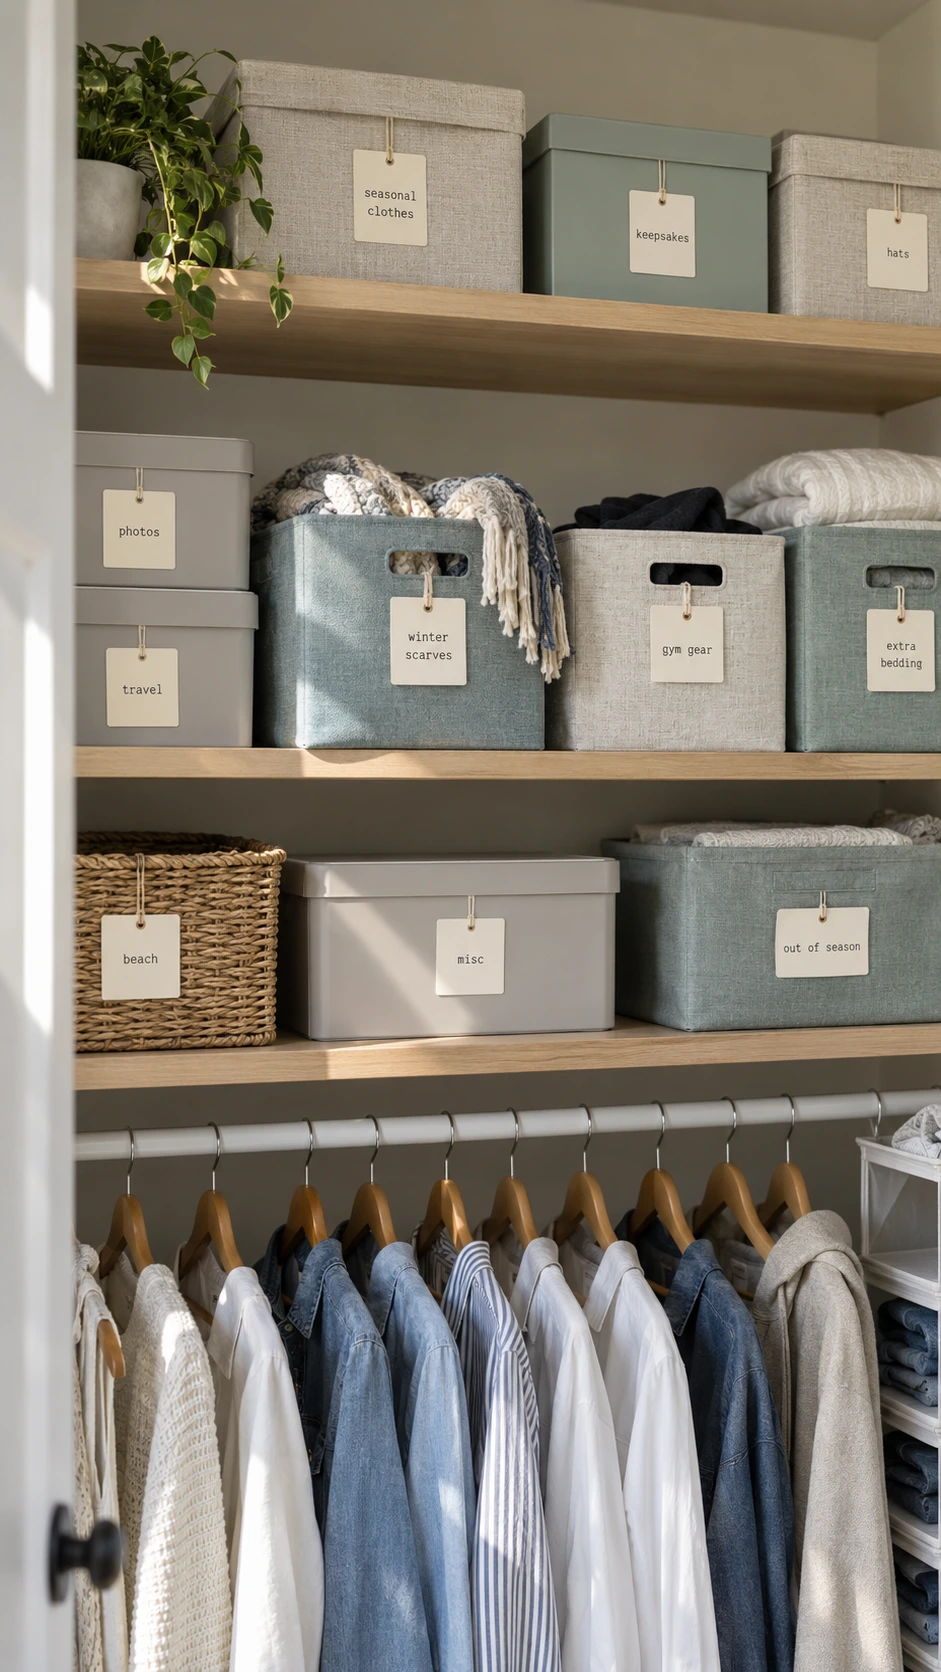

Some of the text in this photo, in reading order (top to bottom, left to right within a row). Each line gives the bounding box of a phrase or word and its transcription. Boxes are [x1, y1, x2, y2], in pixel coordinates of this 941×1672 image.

[364, 189, 417, 202] seasonal
[367, 205, 414, 219] clothes
[636, 228, 690, 243] keepsakes
[887, 247, 910, 259] hats
[118, 525, 160, 539] photos
[407, 631, 449, 643] winter
[662, 645, 713, 657] gym gear
[886, 641, 916, 651] extra
[405, 651, 453, 661] scarves
[880, 657, 923, 671] bedding
[122, 683, 163, 695] travel
[783, 941, 861, 954] out of season
[123, 952, 158, 965] beach
[457, 953, 484, 965] misc
